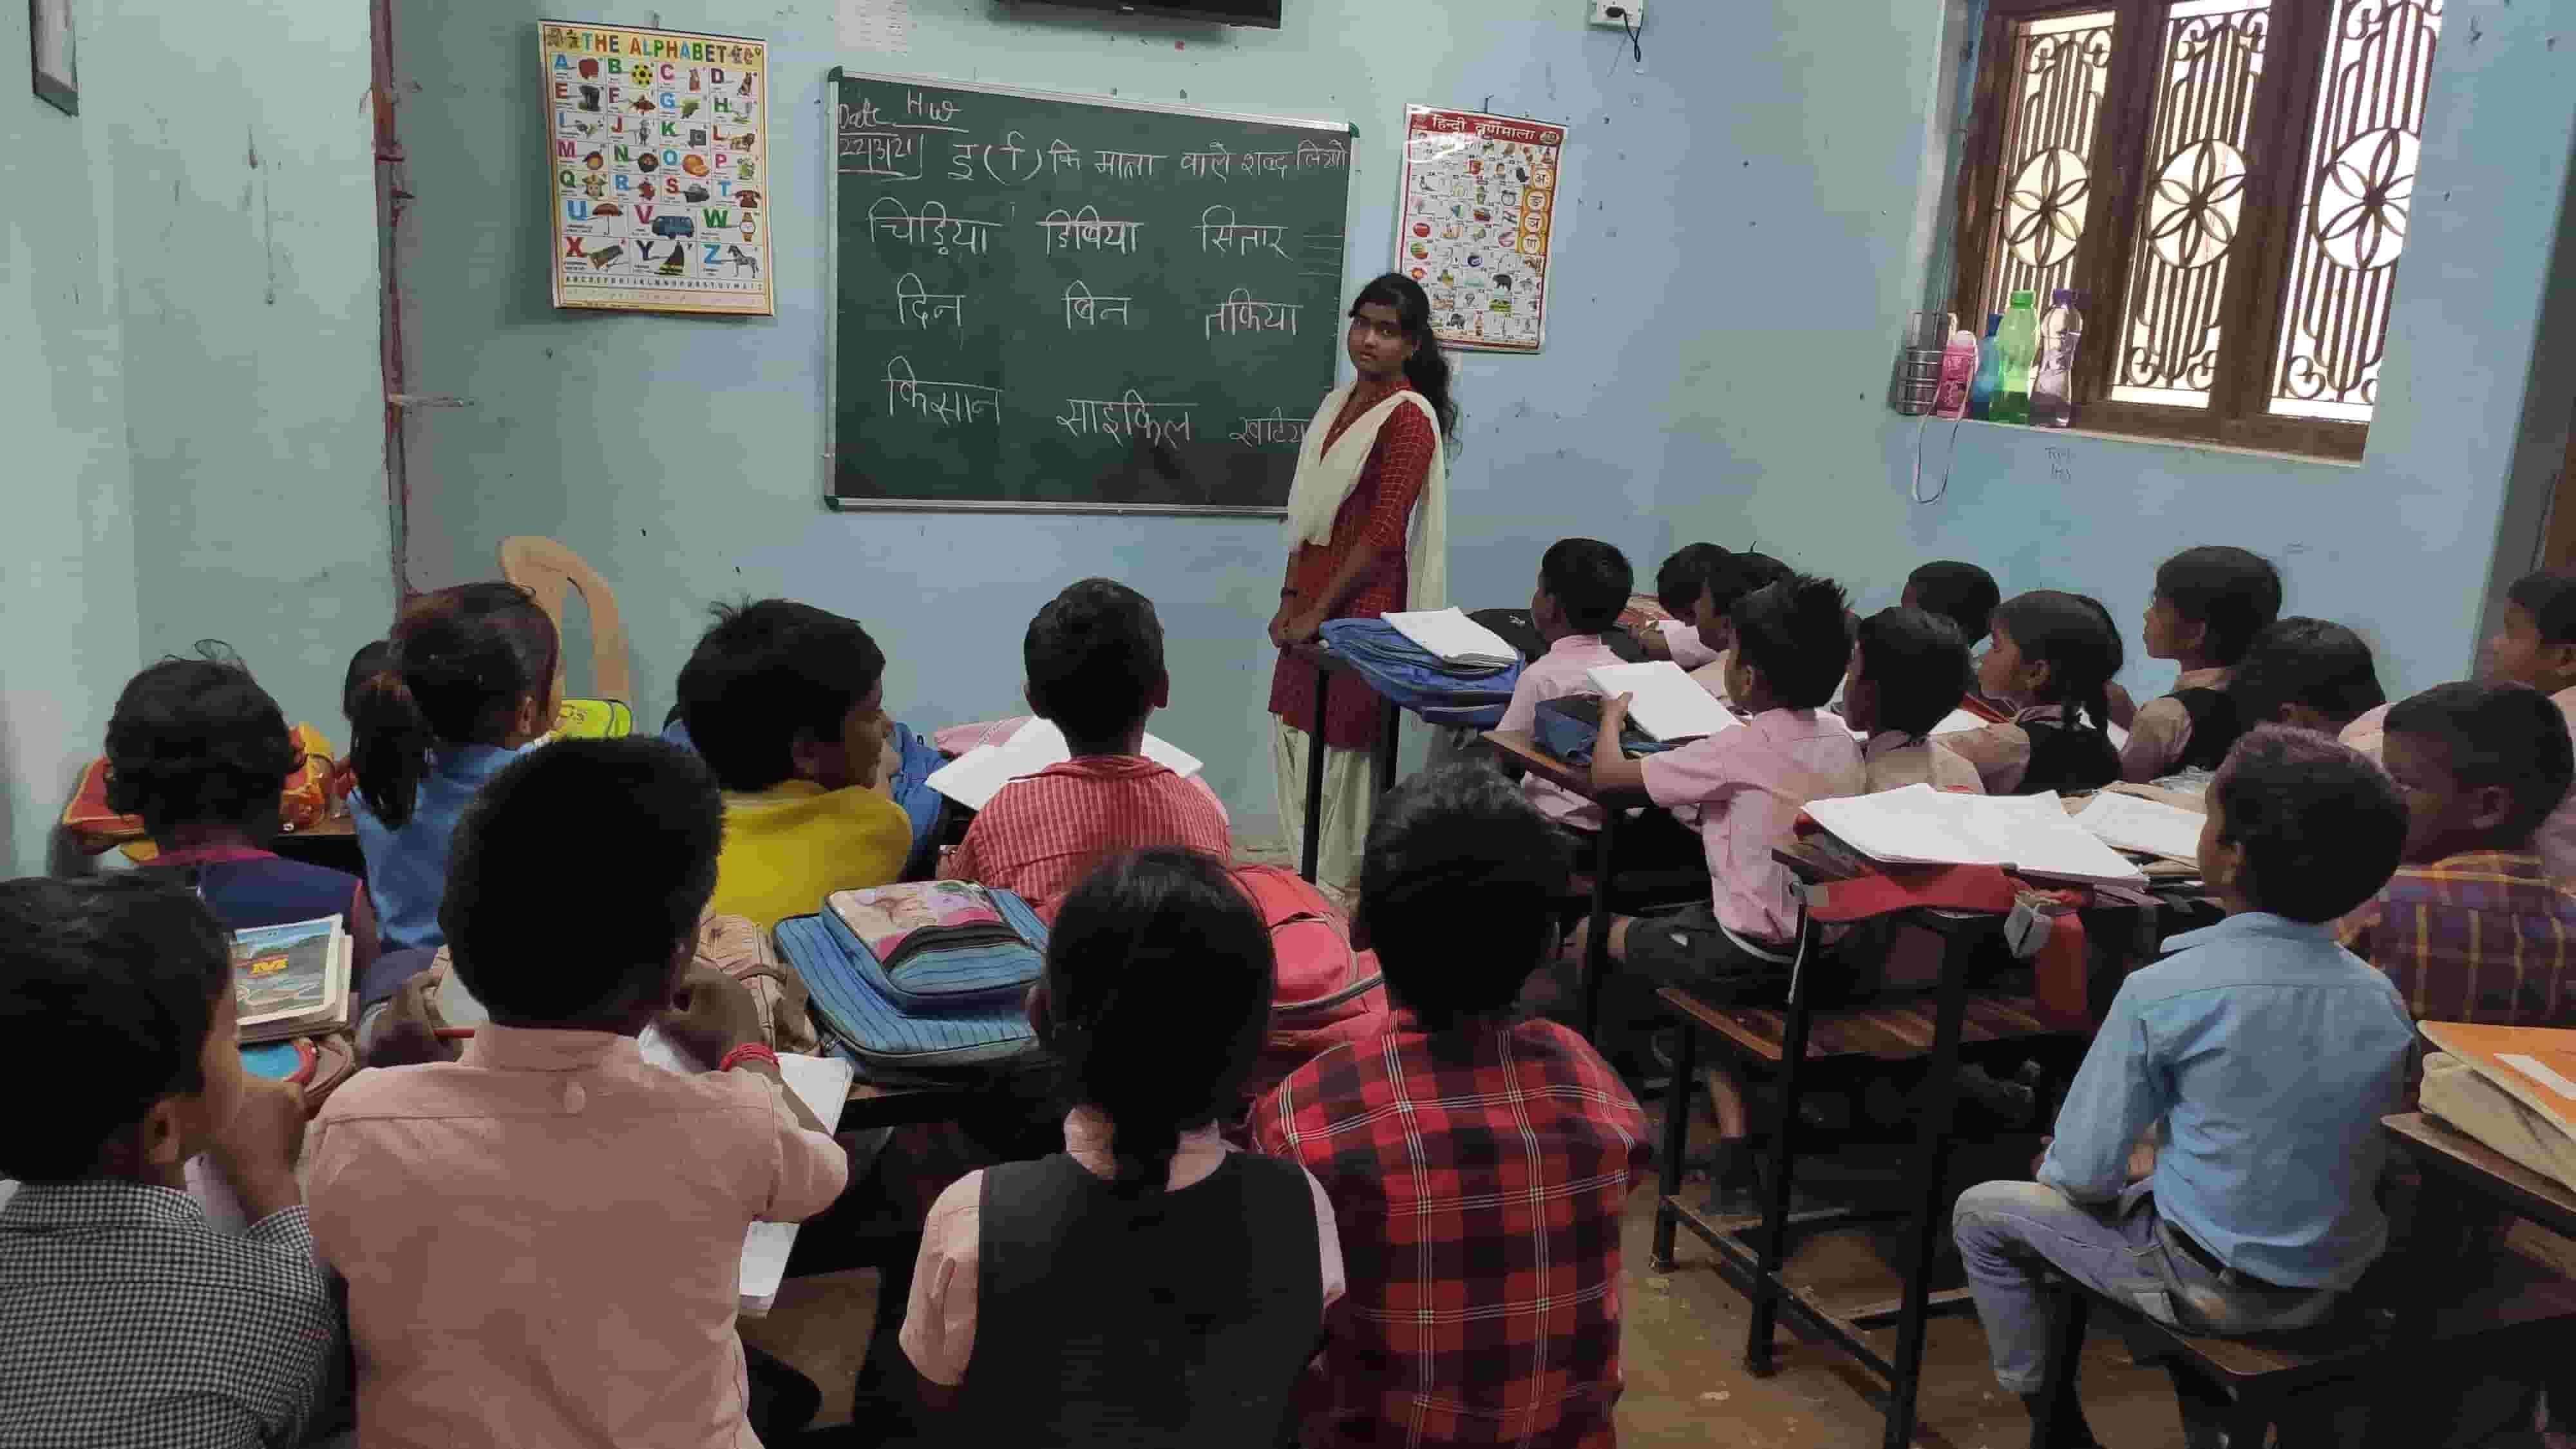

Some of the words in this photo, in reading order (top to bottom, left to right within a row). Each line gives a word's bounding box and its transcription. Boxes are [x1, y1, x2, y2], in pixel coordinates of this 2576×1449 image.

[582, 31, 620, 53] THE
[629, 35, 727, 63] ALPHABET
[554, 54, 569, 70] A
[608, 58, 622, 73] B
[660, 64, 675, 80] C
[711, 68, 724, 84] D
[555, 83, 567, 99] E
[609, 88, 620, 104] F
[659, 93, 675, 109] G
[714, 97, 728, 113] H
[558, 113, 565, 127] I
[611, 116, 623, 133] J
[661, 121, 676, 136] K
[713, 124, 725, 141] L
[558, 140, 575, 158] M
[614, 145, 629, 162] N
[663, 149, 677, 166] O
[715, 154, 727, 169] P
[560, 170, 575, 188] Q
[615, 175, 629, 191] R
[666, 178, 679, 194] S
[718, 180, 732, 197] T
[567, 200, 587, 221] U
[634, 205, 654, 224] V
[703, 207, 728, 229] W
[1189, 204, 1294, 263] सितार
[567, 236, 585, 258] X
[636, 240, 655, 261] Y
[703, 243, 722, 265] Z
[896, 272, 967, 329] दिन
[1205, 287, 1305, 341] तकिया
[880, 355, 1004, 426] किसान
[1056, 388, 1200, 450] साइकिल
